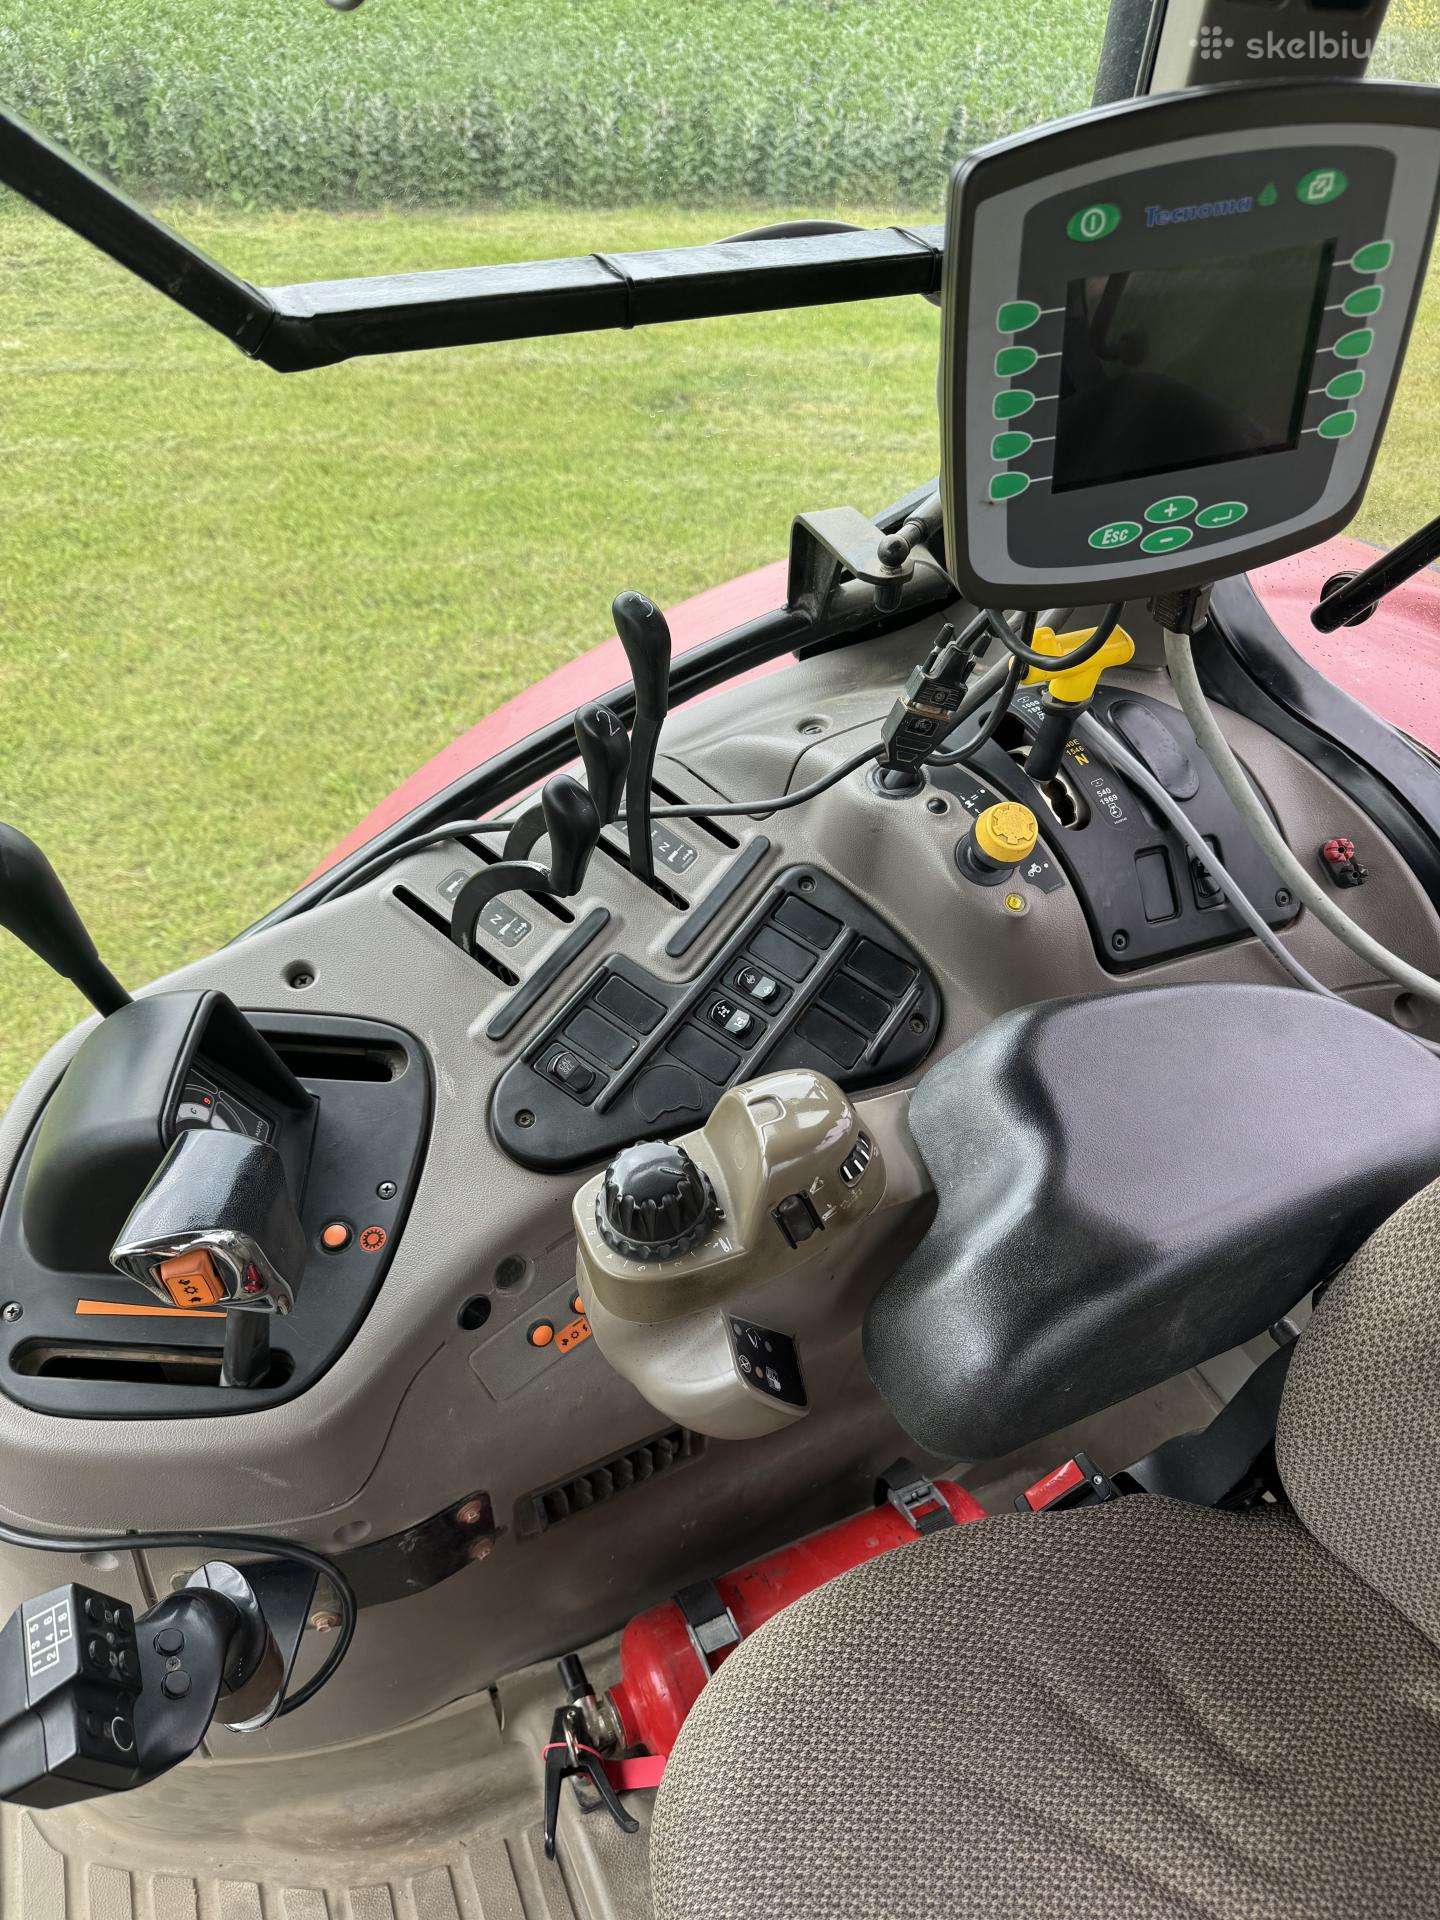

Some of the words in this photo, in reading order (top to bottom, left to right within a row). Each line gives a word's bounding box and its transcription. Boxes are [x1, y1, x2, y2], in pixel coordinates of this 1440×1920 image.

[1144, 196, 1254, 228] Tecnoma
[1101, 528, 1129, 545] Esc
[629, 592, 654, 618] 3
[595, 709, 621, 737] 2
[1074, 753, 1090, 766] N
[1096, 787, 1112, 798] 540
[1099, 794, 1118, 806] 1969
[44, 1616, 52, 1625] 6
[58, 1613, 67, 1622] 8
[30, 1624, 38, 1633] 5
[45, 1633, 53, 1641] 4
[31, 1640, 40, 1650] 3
[47, 1651, 56, 1662] 2
[33, 1660, 41, 1669] 1
